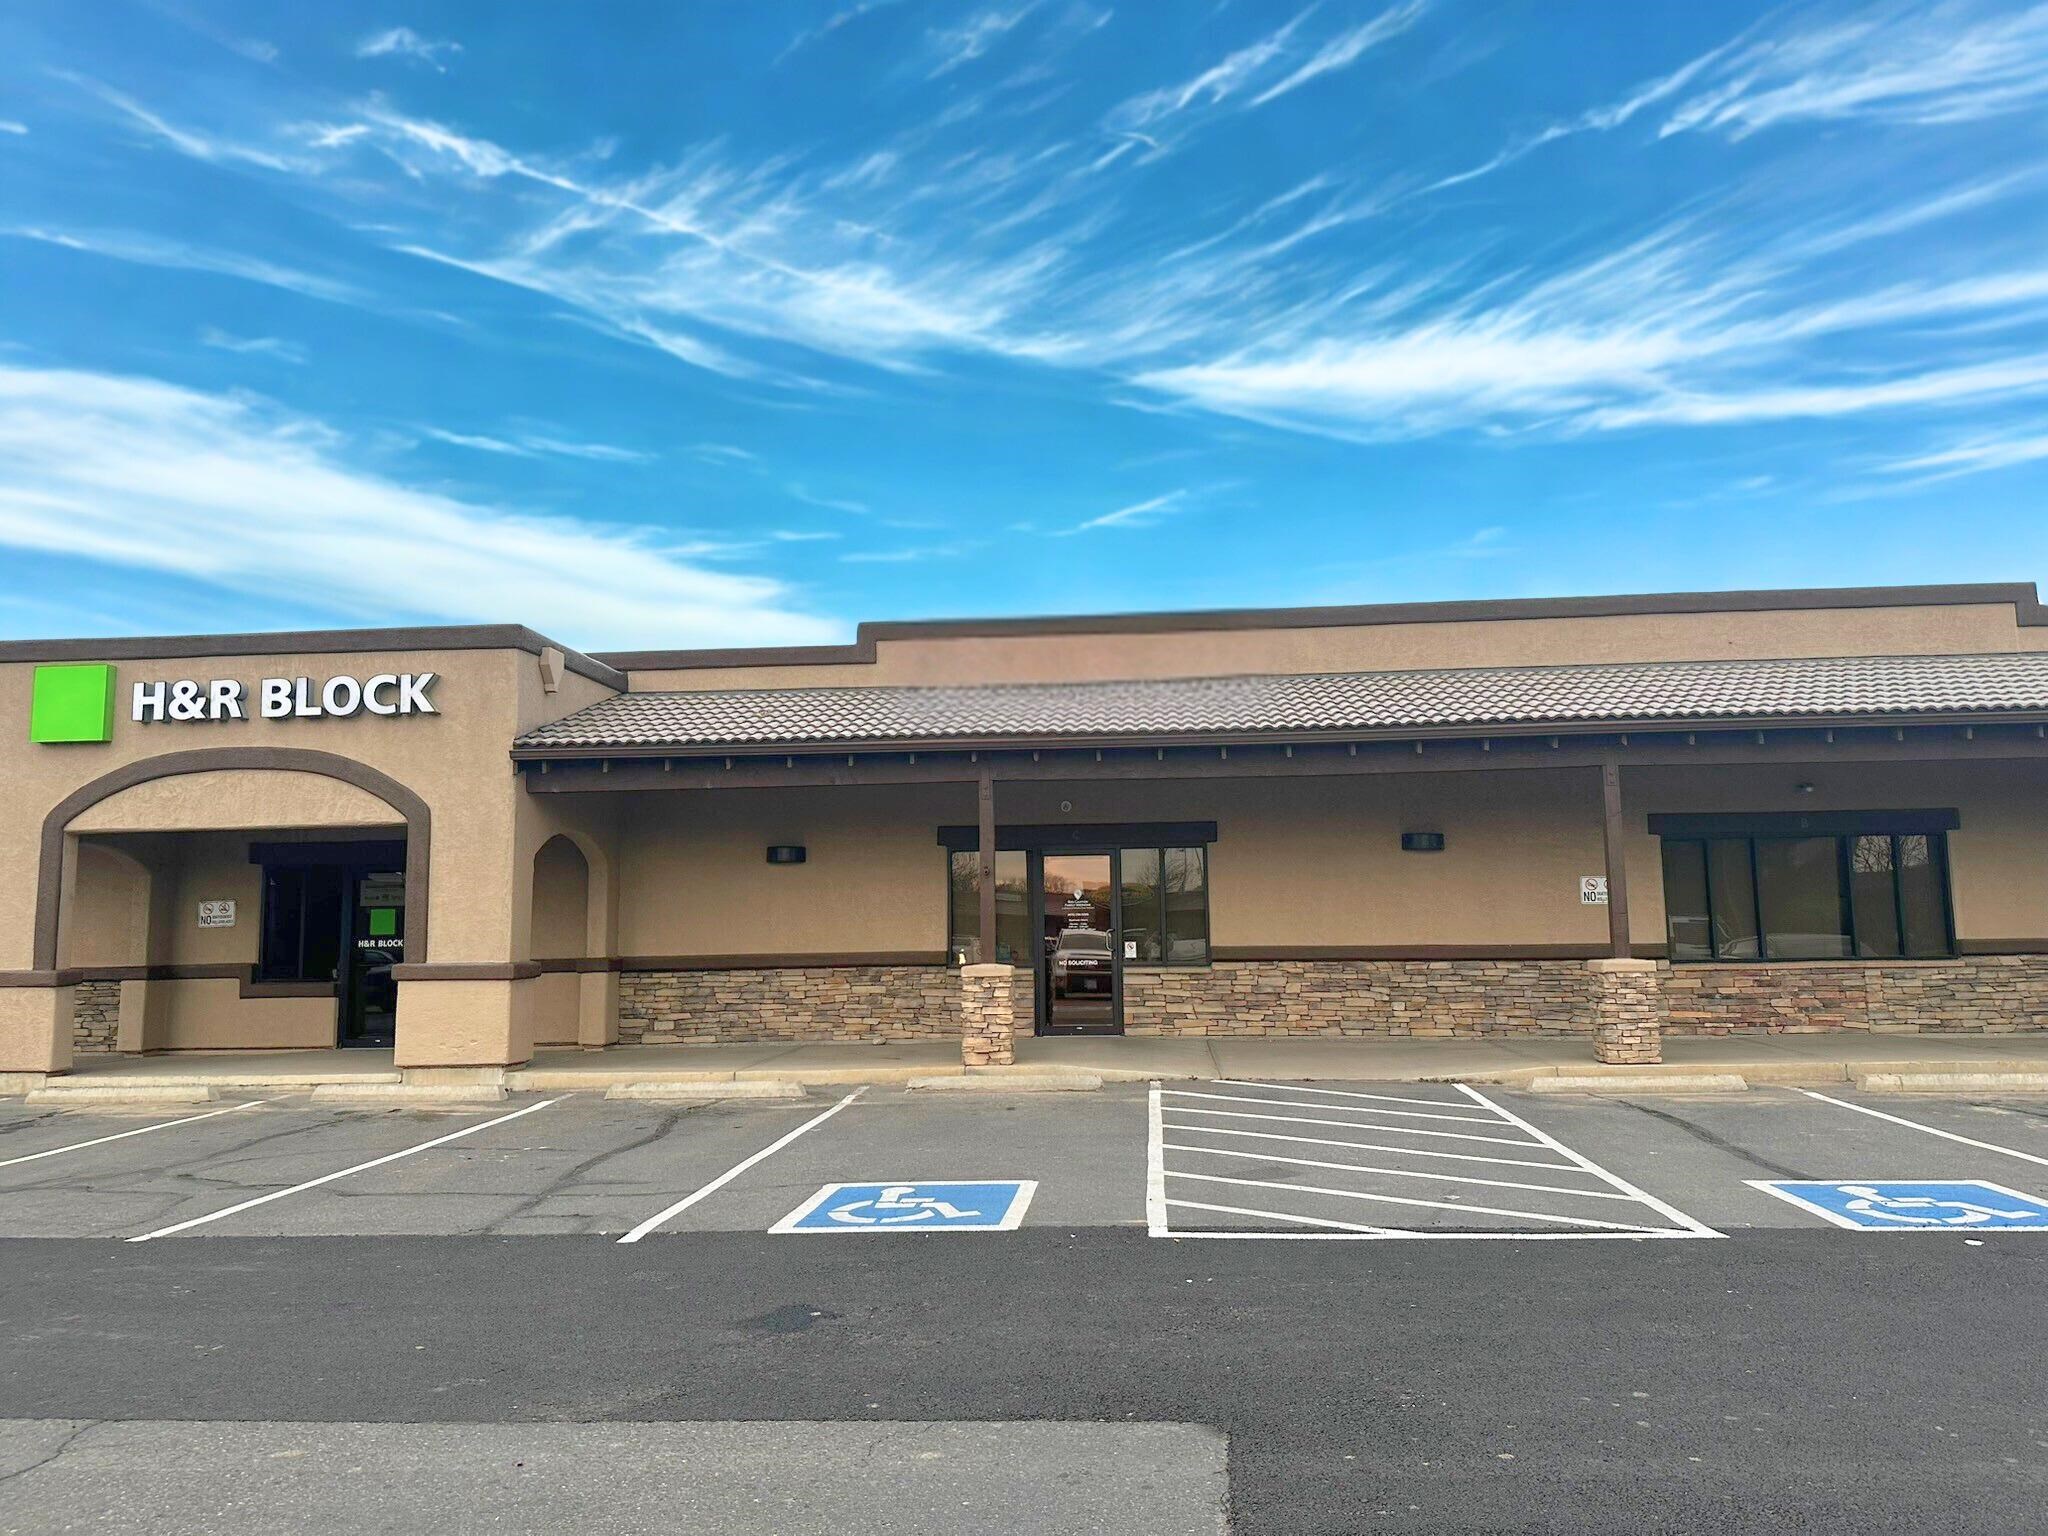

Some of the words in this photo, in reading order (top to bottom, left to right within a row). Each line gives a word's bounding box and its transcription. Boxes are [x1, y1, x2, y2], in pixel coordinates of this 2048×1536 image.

[132, 678, 247, 722] H&R
[261, 672, 439, 719] BLOCK
[1583, 891, 1597, 902] NO
[200, 915, 212, 925] NO
[358, 939, 376, 948] H&R
[377, 939, 404, 948] BLOCK
